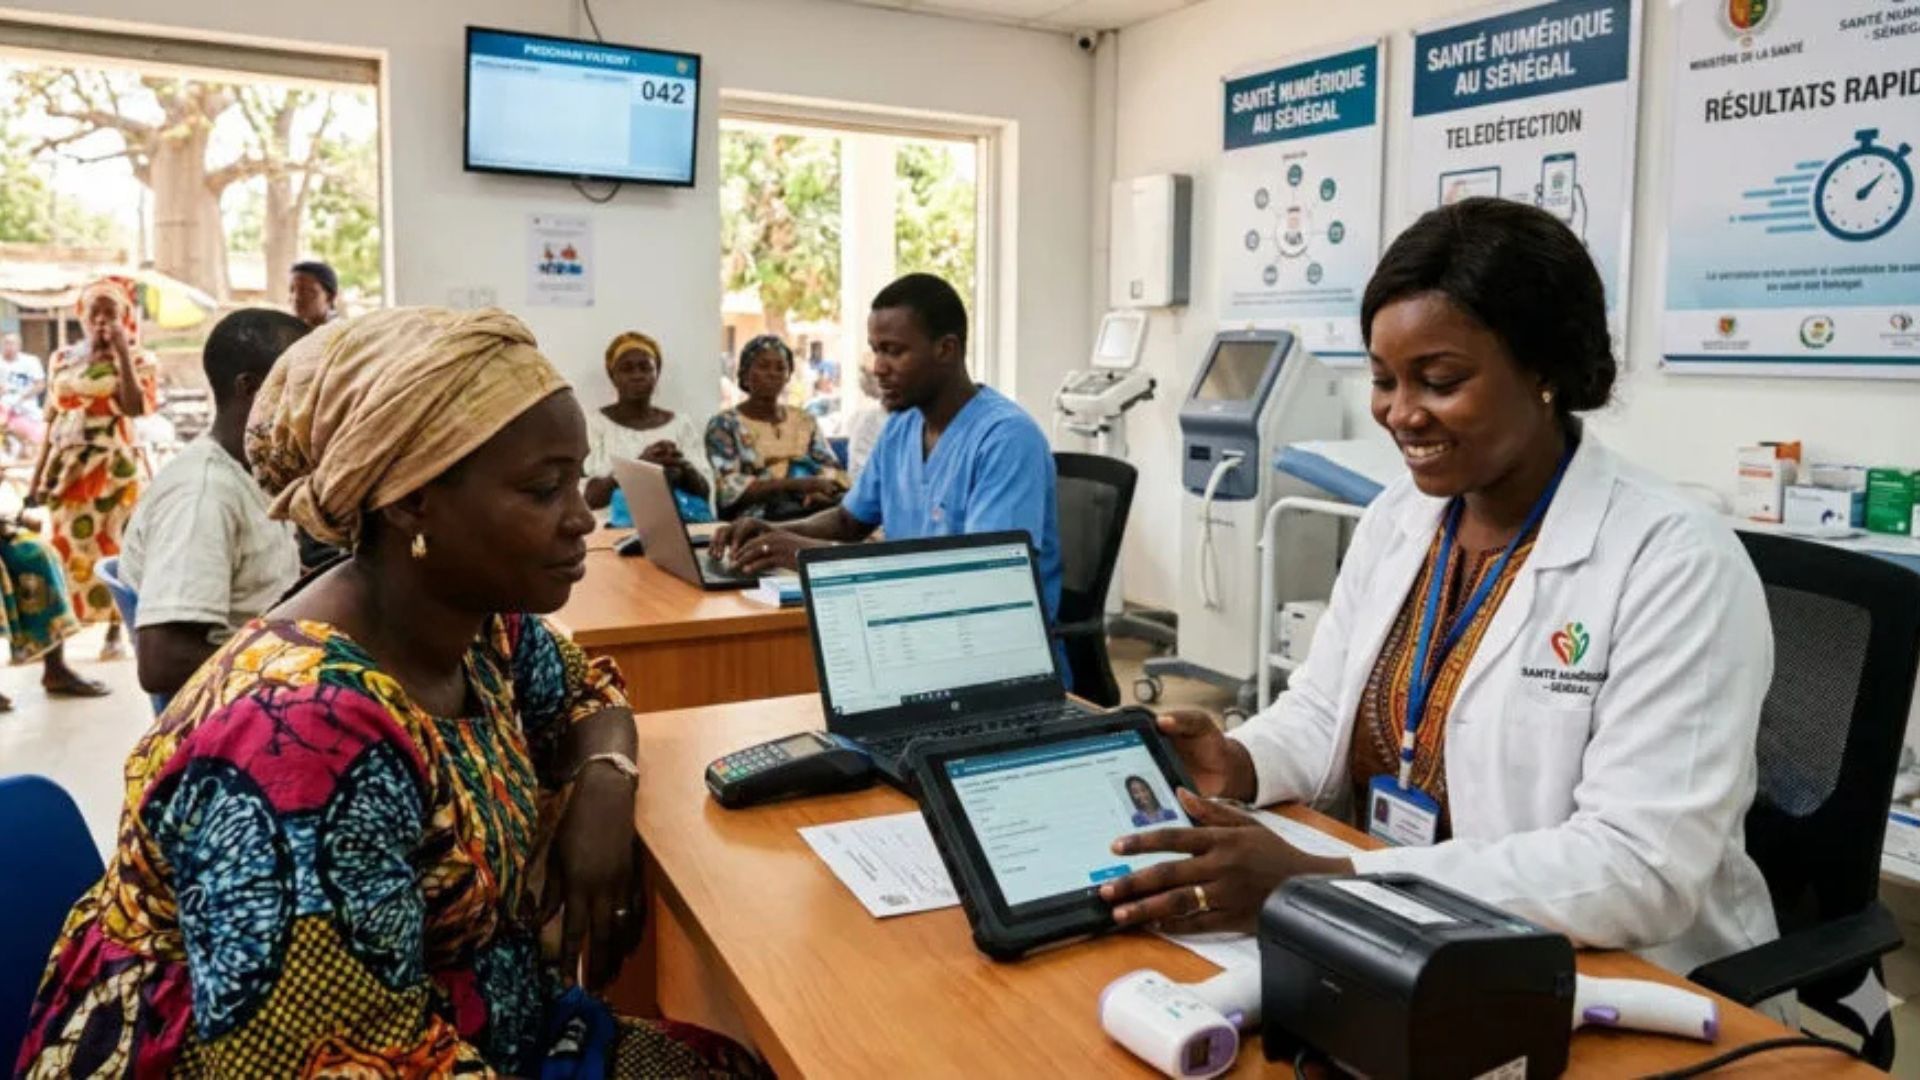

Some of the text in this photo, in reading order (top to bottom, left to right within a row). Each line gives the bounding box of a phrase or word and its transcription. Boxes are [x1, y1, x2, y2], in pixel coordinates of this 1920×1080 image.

[1427, 7, 1614, 71] SANTÉ NUMÉRIQUE
[642, 80, 685, 104] 042
[1231, 64, 1367, 114] SANTÉ NUMÉRIQUE
[1454, 51, 1577, 96] AU SÉNÉGAL
[1252, 99, 1341, 135] AU SÉNÉGAL
[1705, 81, 1837, 124] RÉSULTATS
[1446, 108, 1583, 150] TELEDÉTECTION
